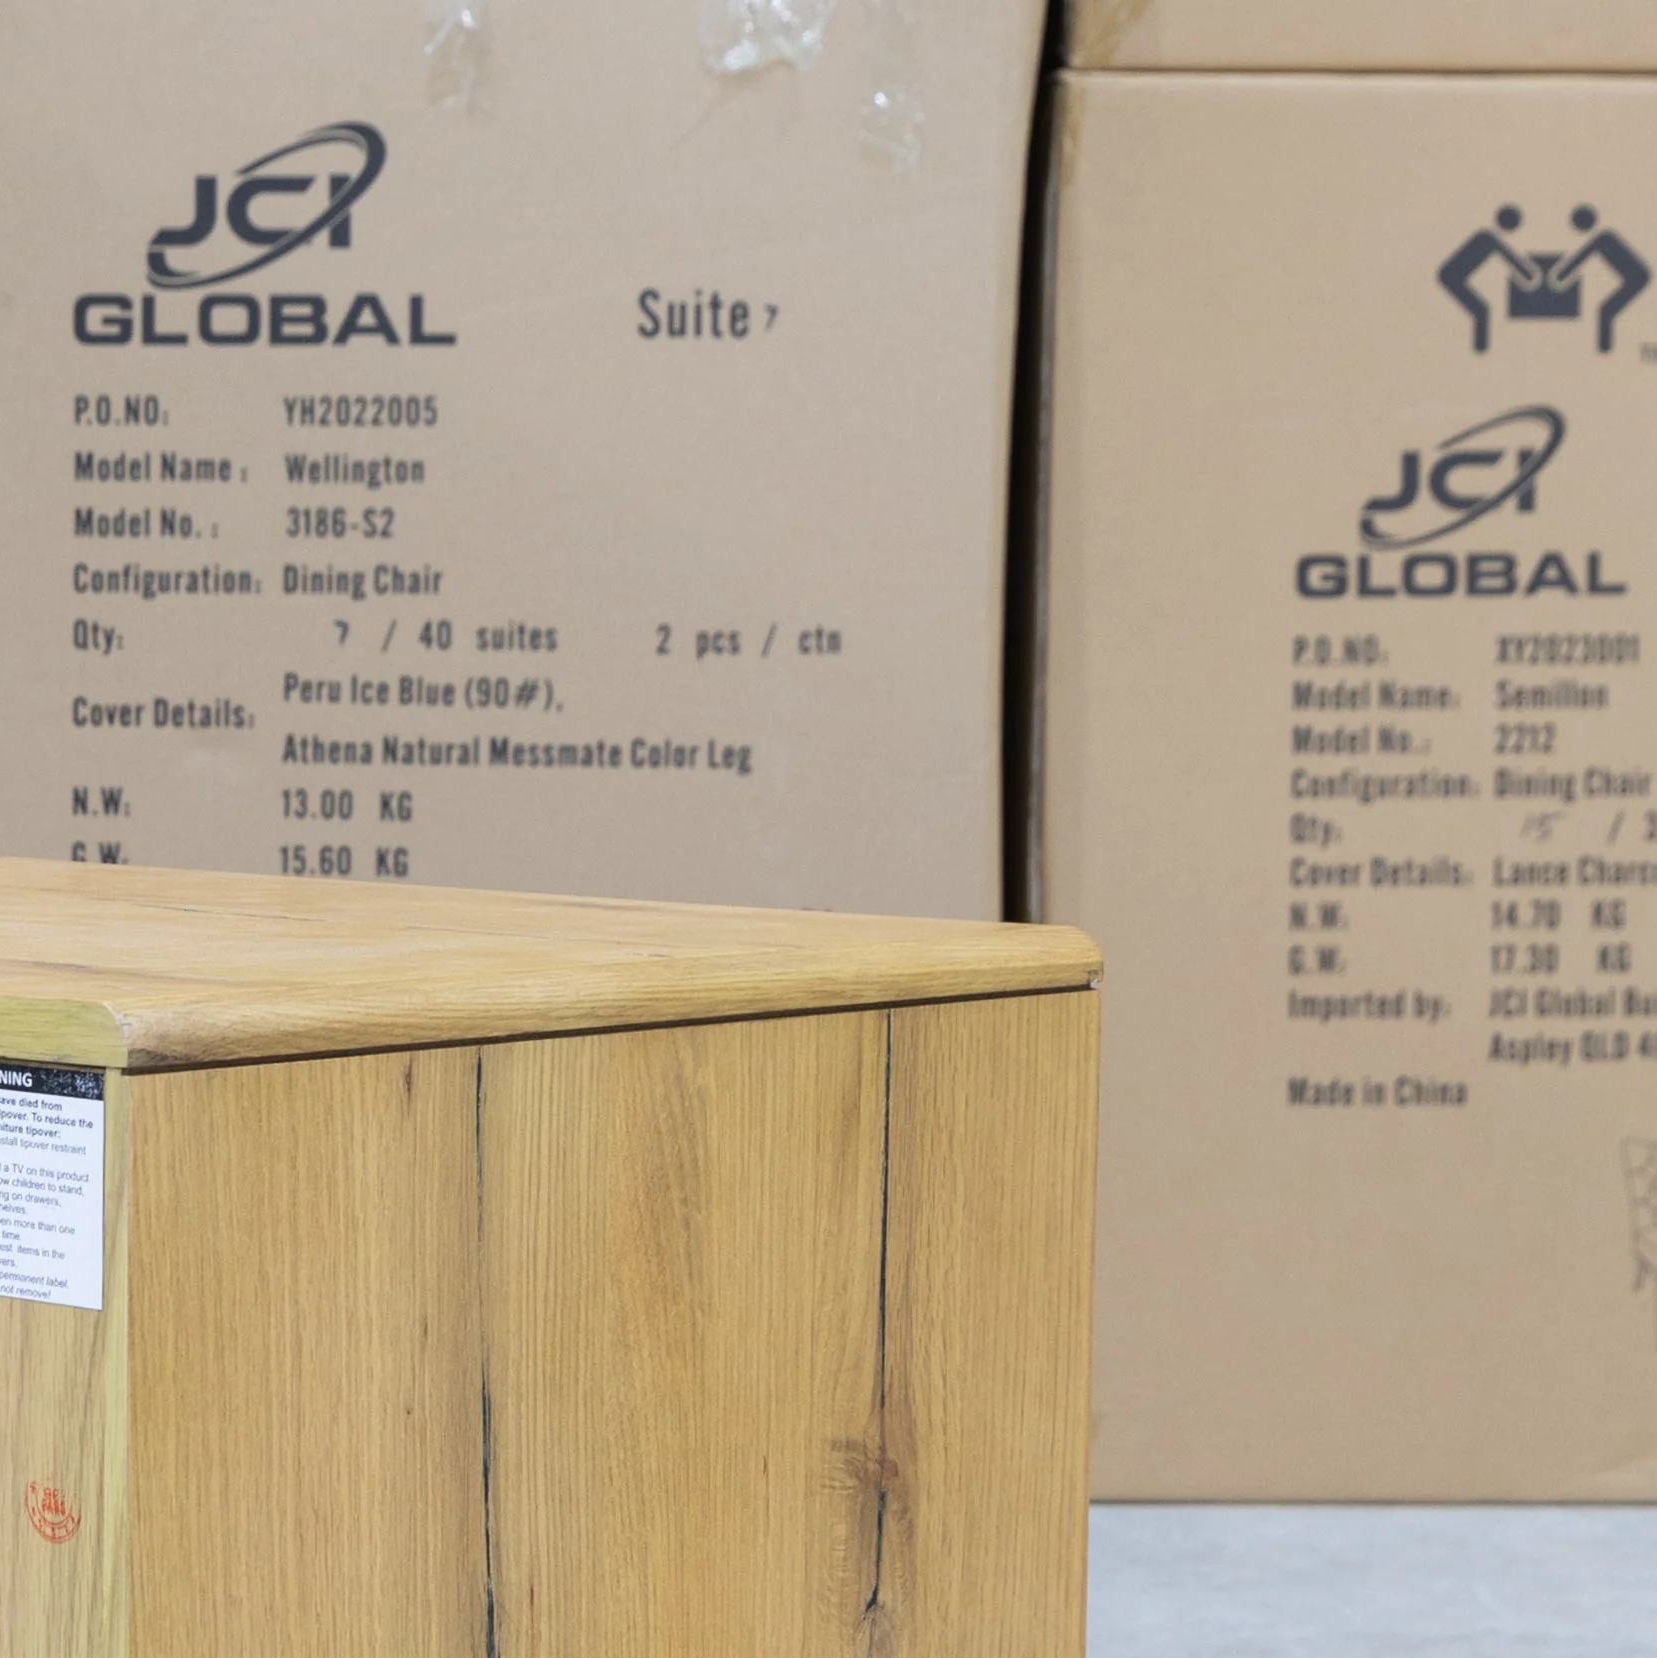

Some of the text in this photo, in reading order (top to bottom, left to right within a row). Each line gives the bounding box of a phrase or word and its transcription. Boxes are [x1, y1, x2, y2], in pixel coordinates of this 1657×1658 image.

[73, 293, 457, 346] GLOBAL
[638, 288, 750, 340] Suite
[283, 395, 438, 427] YH2022005
[74, 452, 425, 490] Model Wellington
[74, 506, 394, 539] Model 3186-S2
[73, 562, 442, 601] Configuration: Dining Chair
[1296, 552, 1627, 599] GLOBAL
[73, 618, 123, 656] Qty:
[419, 619, 452, 651] 40
[476, 622, 558, 652] suites
[656, 623, 671, 656] 2
[696, 630, 741, 660] pcs
[798, 626, 842, 655] ctn
[283, 672, 456, 707] Peru Ice Blue
[1292, 681, 1370, 711] Model
[72, 696, 254, 729] Cover Details:
[282, 733, 752, 776] Athena Natural Messmate Color Leg
[1292, 725, 1370, 755] Model
[1494, 767, 1577, 804] Dining
[1583, 766, 1651, 799] Chair
[282, 788, 412, 822] 13.00 KG
[279, 844, 408, 878] 15.60 KG
[1289, 856, 1362, 888] Cover
[1288, 990, 1406, 1023] Imported
[19, 1097, 38, 1108] died
[42, 1100, 62, 1111] from
[1287, 1075, 1468, 1107] Made in China
[31, 1112, 42, 1123] To
[45, 1116, 75, 1126] reduce
[79, 1119, 93, 1128] the
[12, 1163, 24, 1173] TV
[26, 1167, 37, 1175] on
[40, 1167, 54, 1178] this
[57, 1171, 89, 1182] product
[12, 1179, 45, 1190] children
[48, 1183, 56, 1191] to
[14, 1220, 35, 1229] more
[38, 1221, 56, 1231] than
[59, 1225, 75, 1235] one
[17, 1244, 40, 1256] items
[52, 1249, 65, 1260] the
[0, 1284, 13, 1294] not
